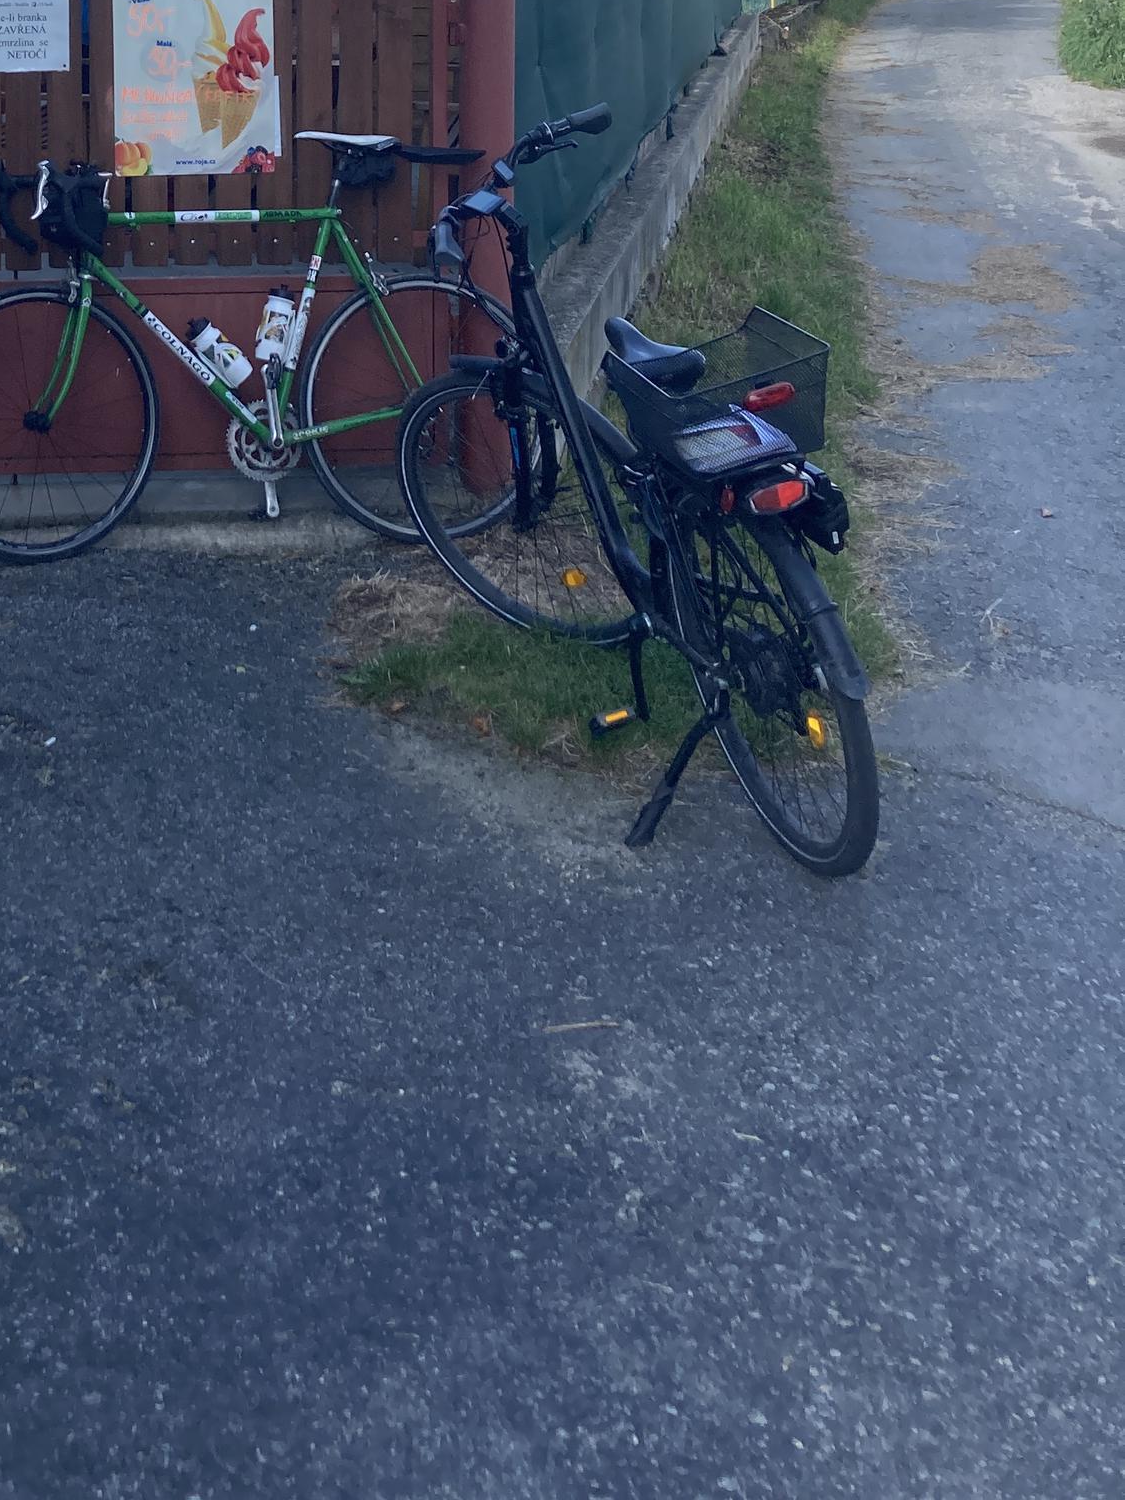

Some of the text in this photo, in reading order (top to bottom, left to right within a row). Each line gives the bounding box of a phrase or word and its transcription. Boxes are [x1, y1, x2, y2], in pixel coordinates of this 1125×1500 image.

[17, 13, 48, 22] branka
[7, 49, 47, 59] NETOČÍ
[175, 158, 216, 166] www.roja.cz
[153, 322, 212, 382] COLNAGO
